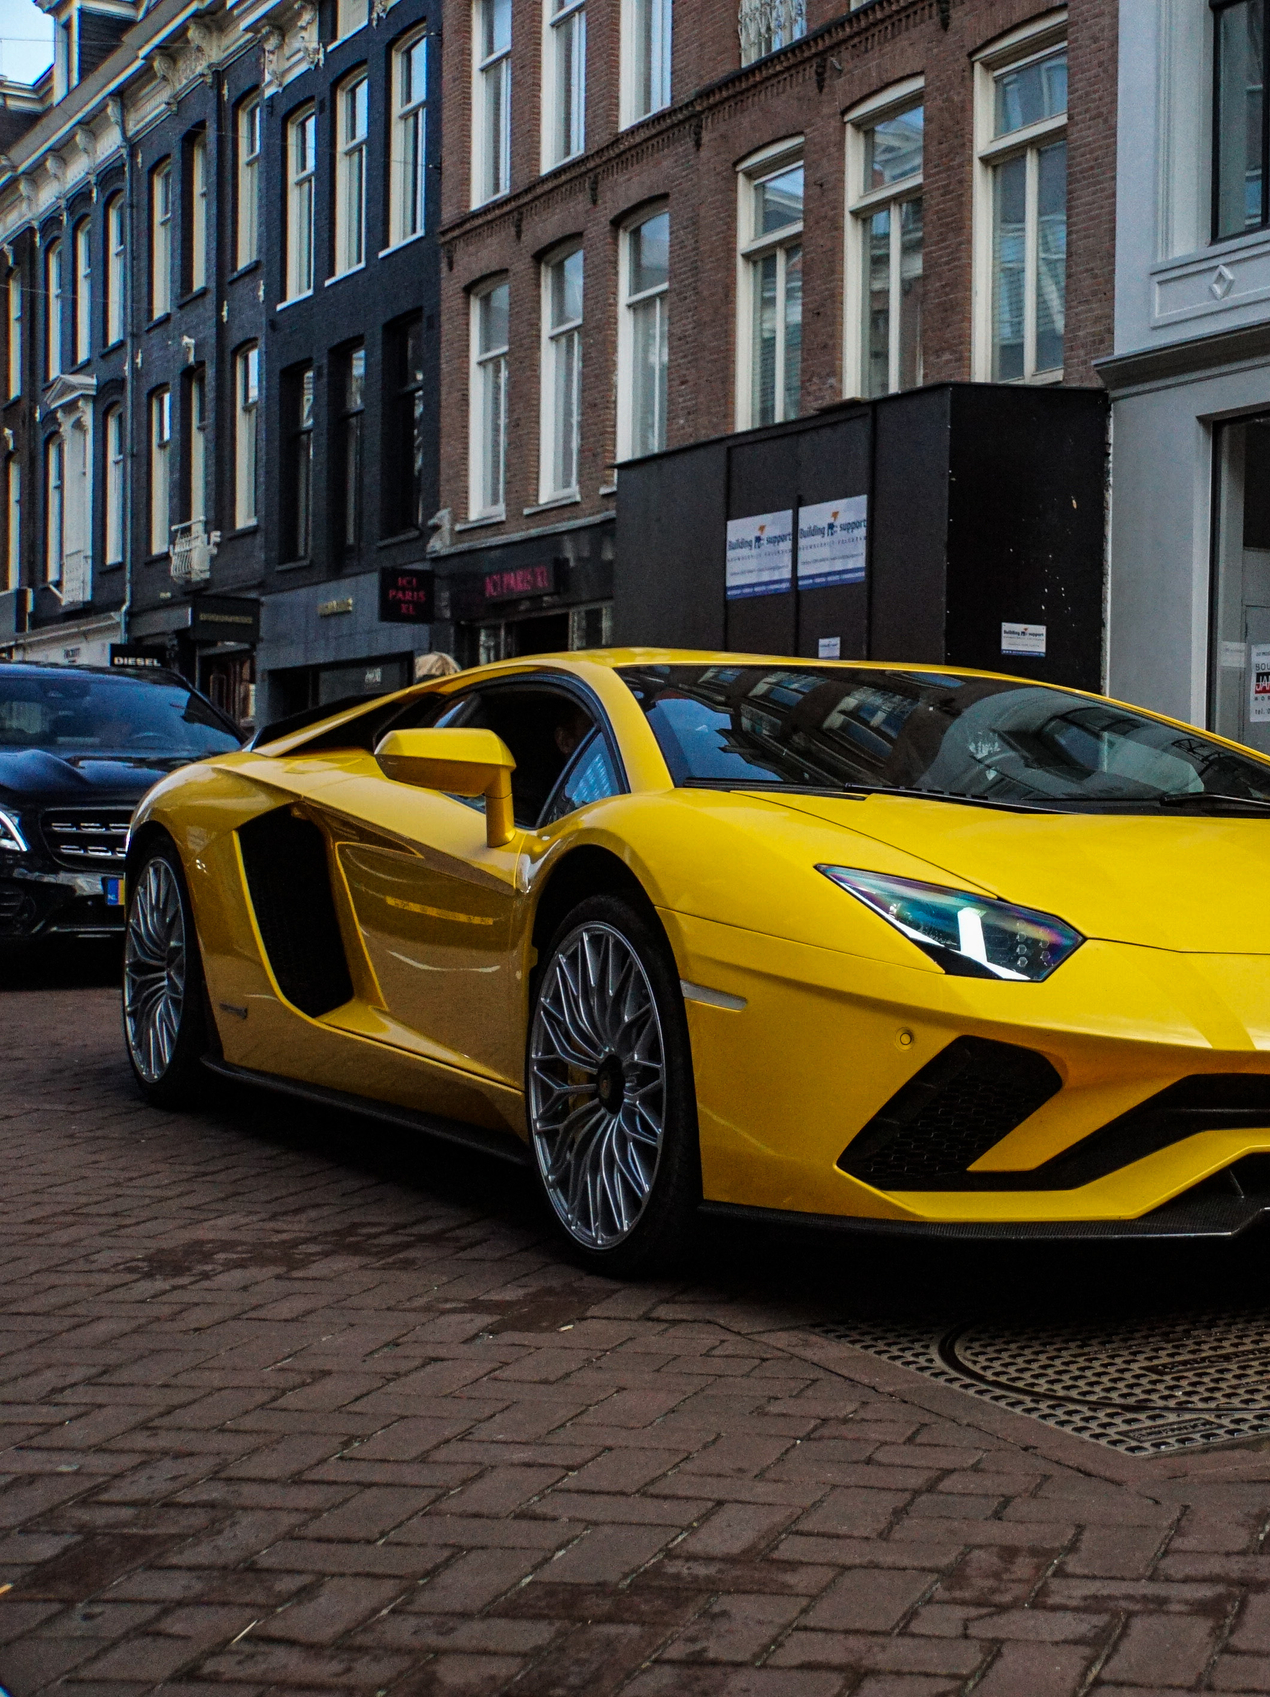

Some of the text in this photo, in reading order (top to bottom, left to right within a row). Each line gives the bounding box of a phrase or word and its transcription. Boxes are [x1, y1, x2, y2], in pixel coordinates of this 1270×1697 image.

[397, 576, 417, 588] ICI
[389, 590, 426, 601] PARIS
[401, 604, 416, 615] XL
[113, 656, 162, 667] DIESEL
